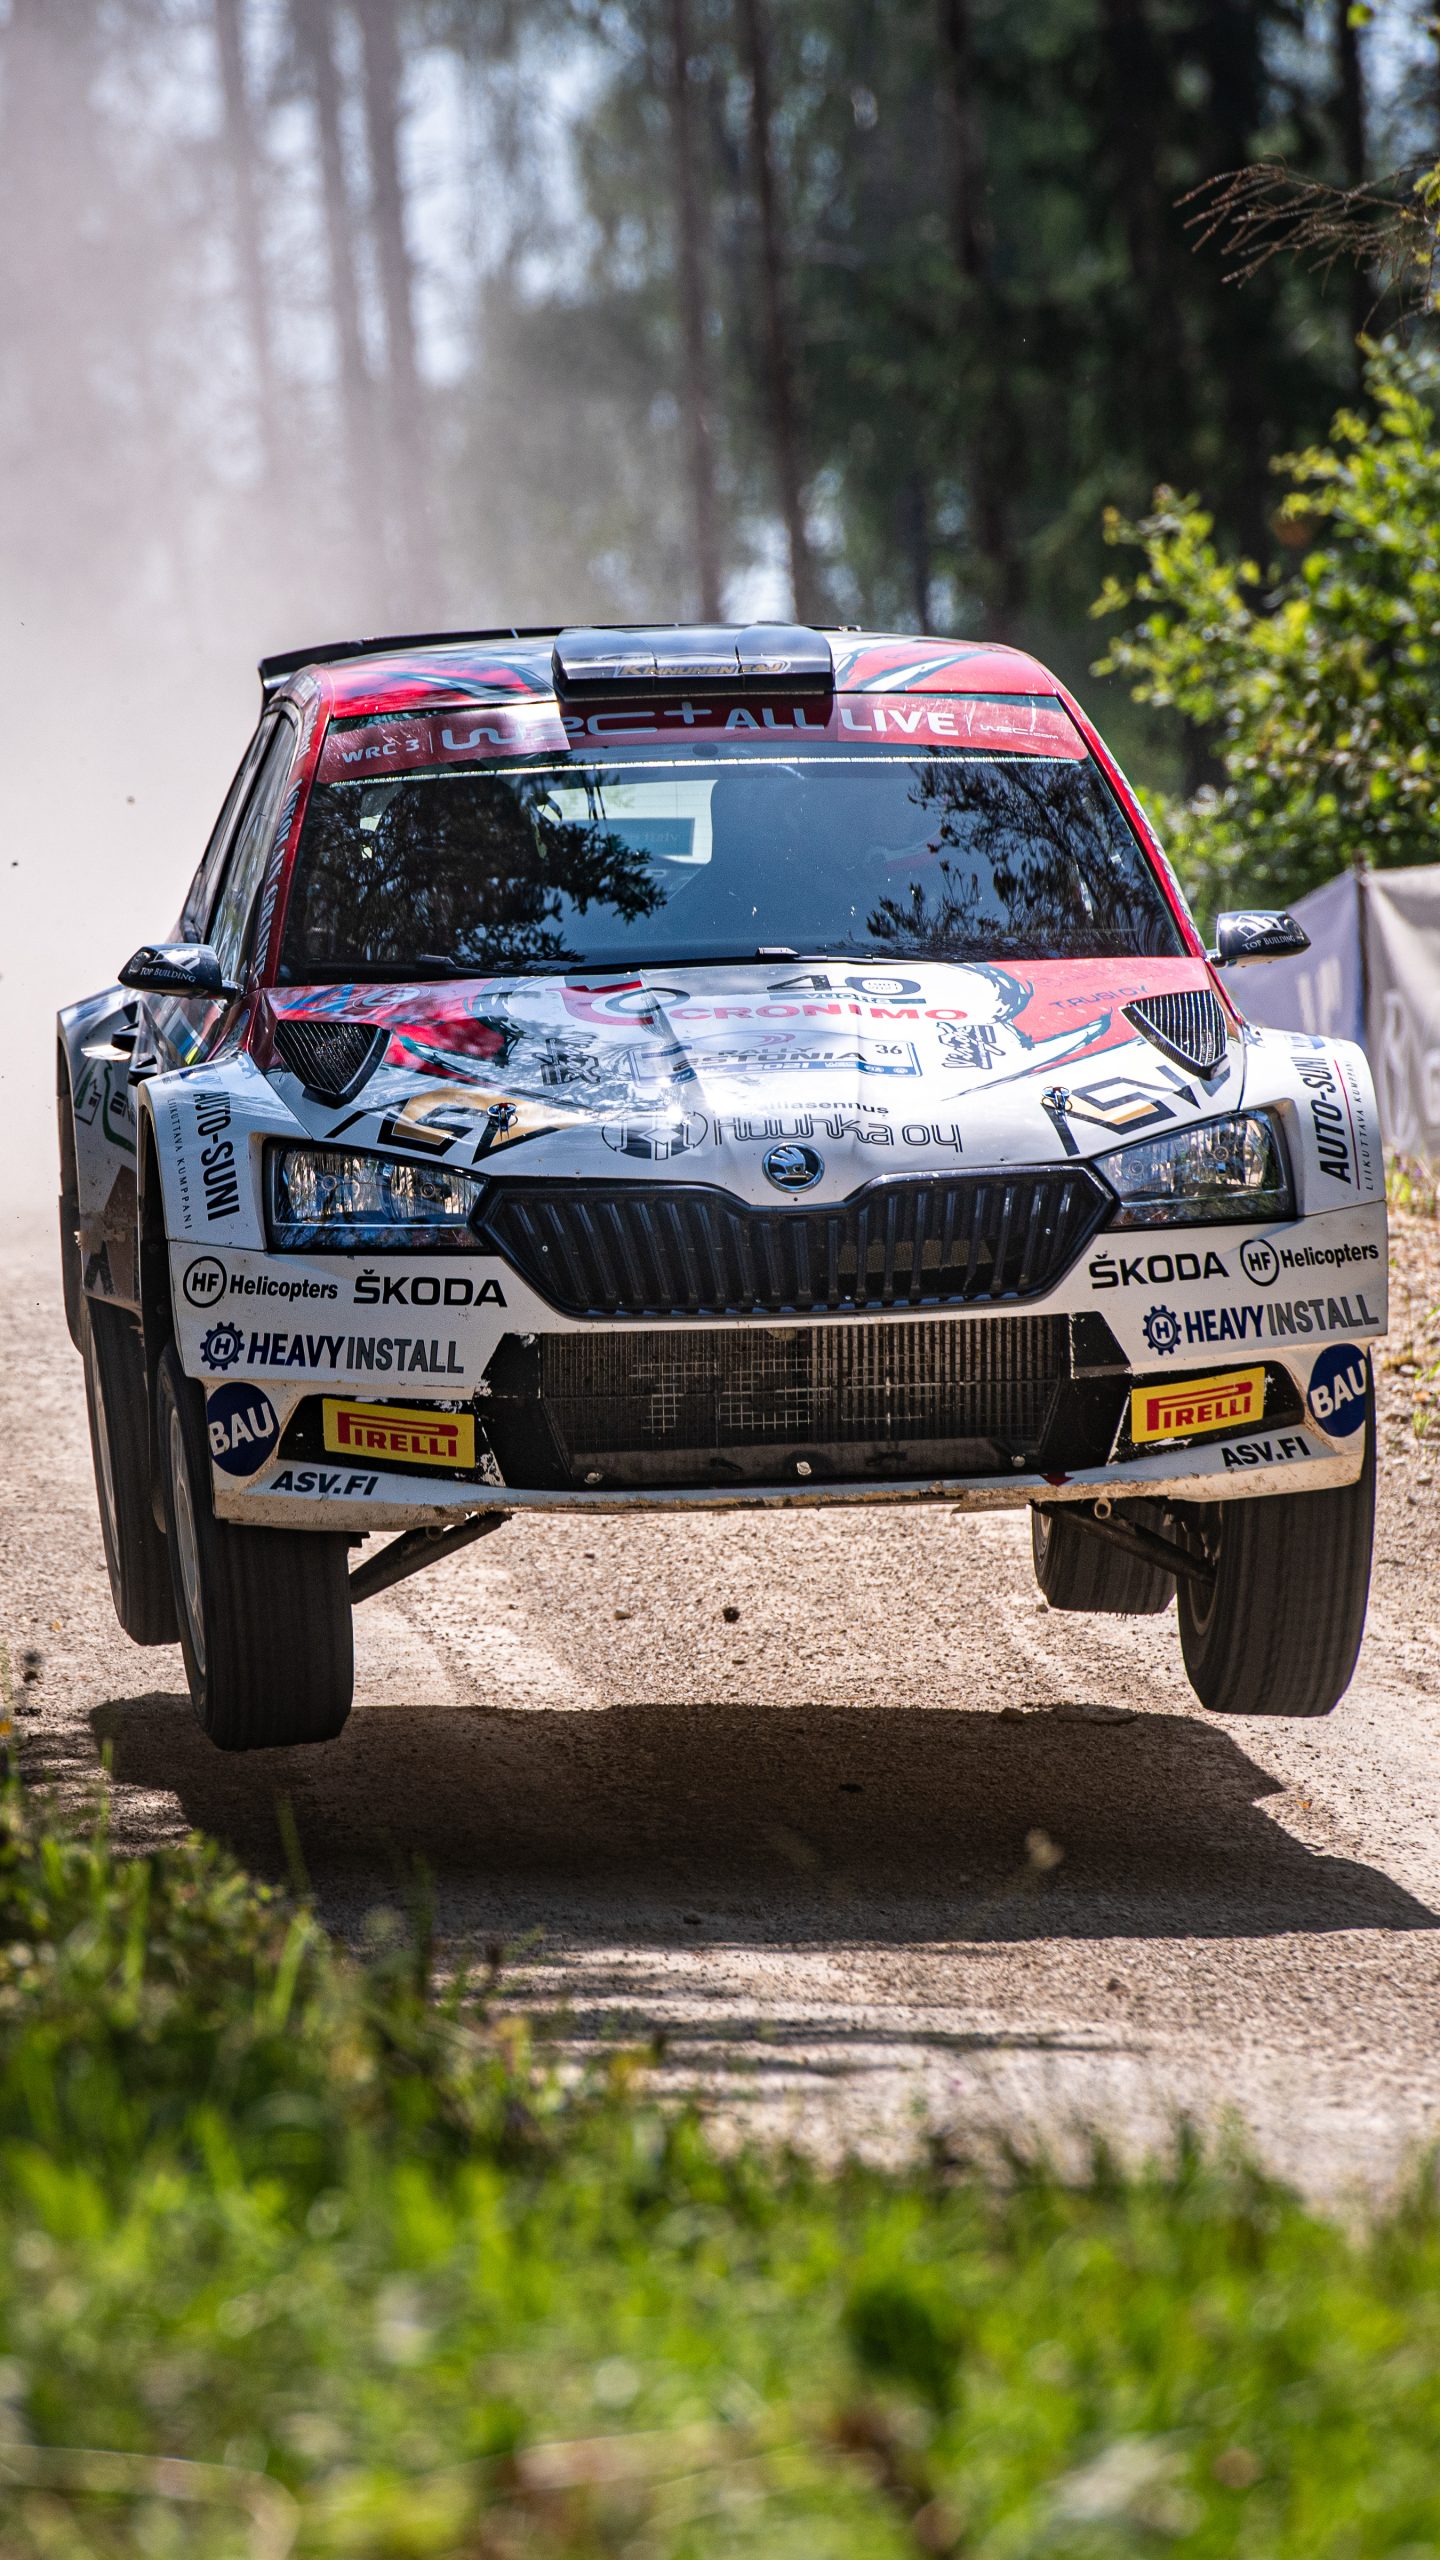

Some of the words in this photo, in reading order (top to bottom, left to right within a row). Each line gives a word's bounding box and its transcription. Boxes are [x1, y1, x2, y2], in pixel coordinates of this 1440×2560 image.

[621, 665, 737, 675] KINNUNEN
[741, 663, 784, 673] E&J
[724, 707, 825, 731] ALL
[840, 708, 959, 736] LIVE
[340, 742, 397, 763] WRC
[405, 738, 420, 752] 3
[1242, 940, 1262, 951] TOP
[1264, 934, 1296, 946] BUILDING
[140, 966, 154, 976] TOP
[153, 967, 197, 983] BUILDING
[767, 974, 922, 996] 40
[670, 1003, 969, 1021] CRONIMO
[672, 1052, 867, 1072] ESTONIA
[718, 1046, 817, 1056] RALLY
[874, 1044, 904, 1056] 36
[745, 1062, 809, 1071] 2021
[713, 1113, 895, 1146] Huuhka
[1290, 1056, 1352, 1185] AUTO-SUNI
[167, 1097, 184, 1152] LIIKUTTAVA
[176, 1157, 193, 1230] KUMPPANI
[193, 1091, 240, 1221] AUTO-SUNI
[1355, 1109, 1374, 1191] LIIKUTTAVA
[1088, 1252, 1230, 1290] ŠKODA
[1247, 1250, 1272, 1272] HF
[1279, 1243, 1380, 1269] Helicopters
[192, 1272, 219, 1292] HF
[229, 1274, 339, 1303] Helicopters
[353, 1268, 508, 1308] ŠKODA
[1155, 1321, 1170, 1339] H
[214, 1337, 231, 1355] H
[1310, 1358, 1367, 1419] BAU
[1146, 1381, 1254, 1432] PIRELLI
[208, 1401, 275, 1457] BAU
[337, 1411, 459, 1458] PIRELLI
[1220, 1435, 1312, 1468] ASV.FI
[269, 1470, 379, 1496] ASV.FI
